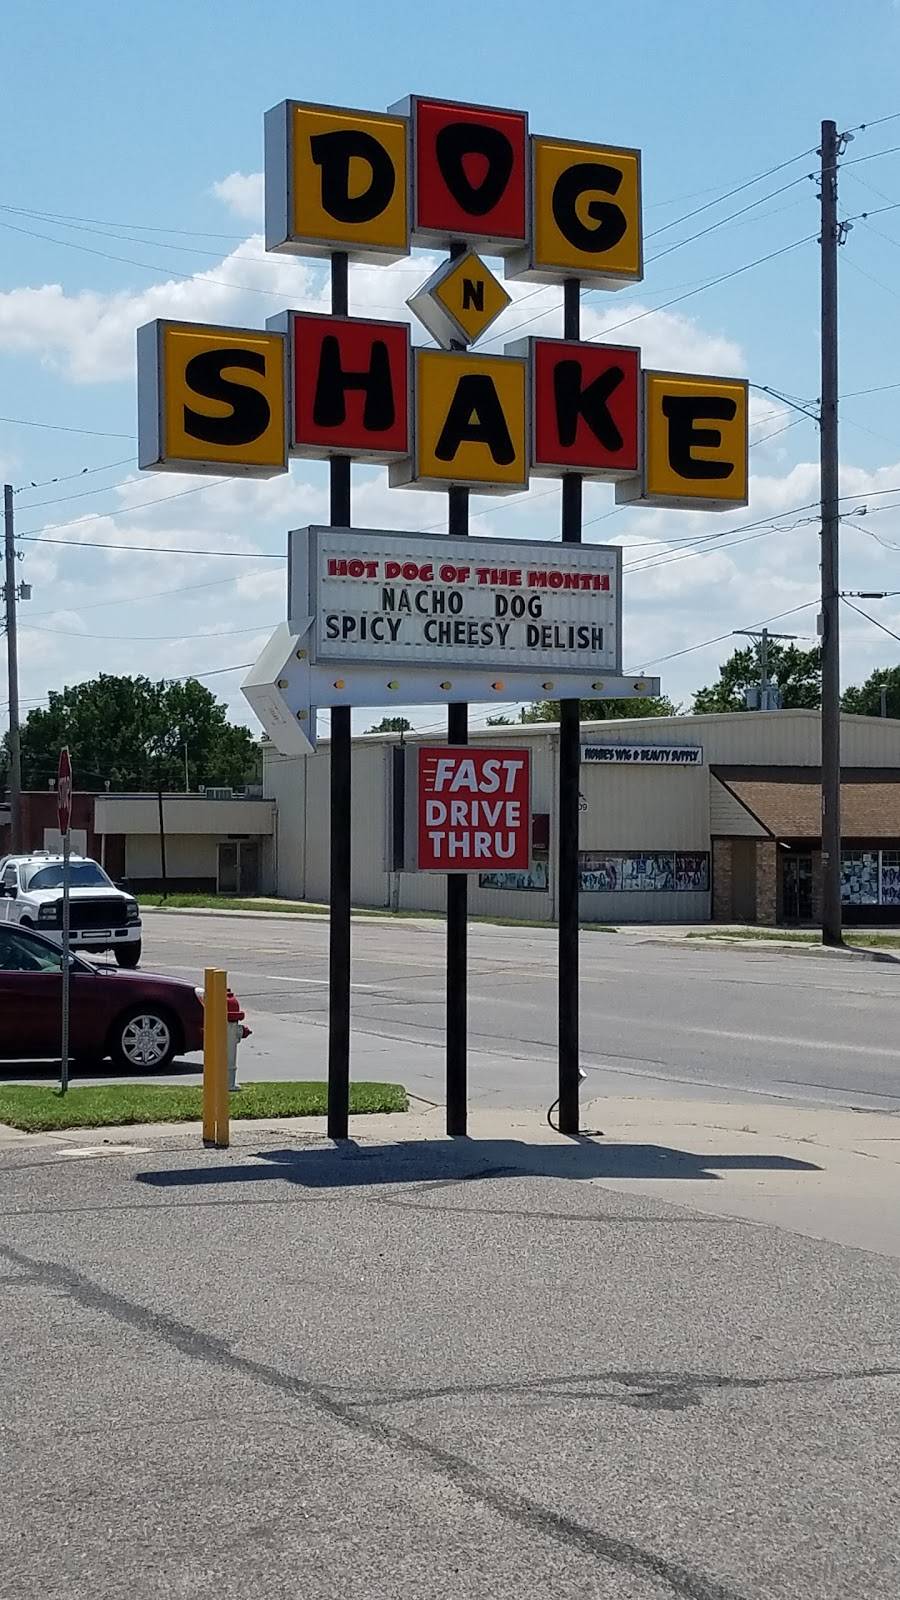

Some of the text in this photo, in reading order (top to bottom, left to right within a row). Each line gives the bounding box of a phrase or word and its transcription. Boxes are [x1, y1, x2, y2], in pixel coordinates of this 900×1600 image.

[310, 122, 627, 253] DOG
[462, 278, 484, 312] N
[183, 335, 737, 480] SHAKE
[327, 558, 610, 592] HOT DOG OF THE MONTH
[382, 587, 543, 619] NACHO DOG
[326, 614, 604, 650] SPICY CHEESY DELISH
[640, 749, 671, 762] BEAUTY
[434, 759, 524, 793] FAST
[425, 800, 521, 827] DRIVE
[428, 831, 516, 859] THRU
